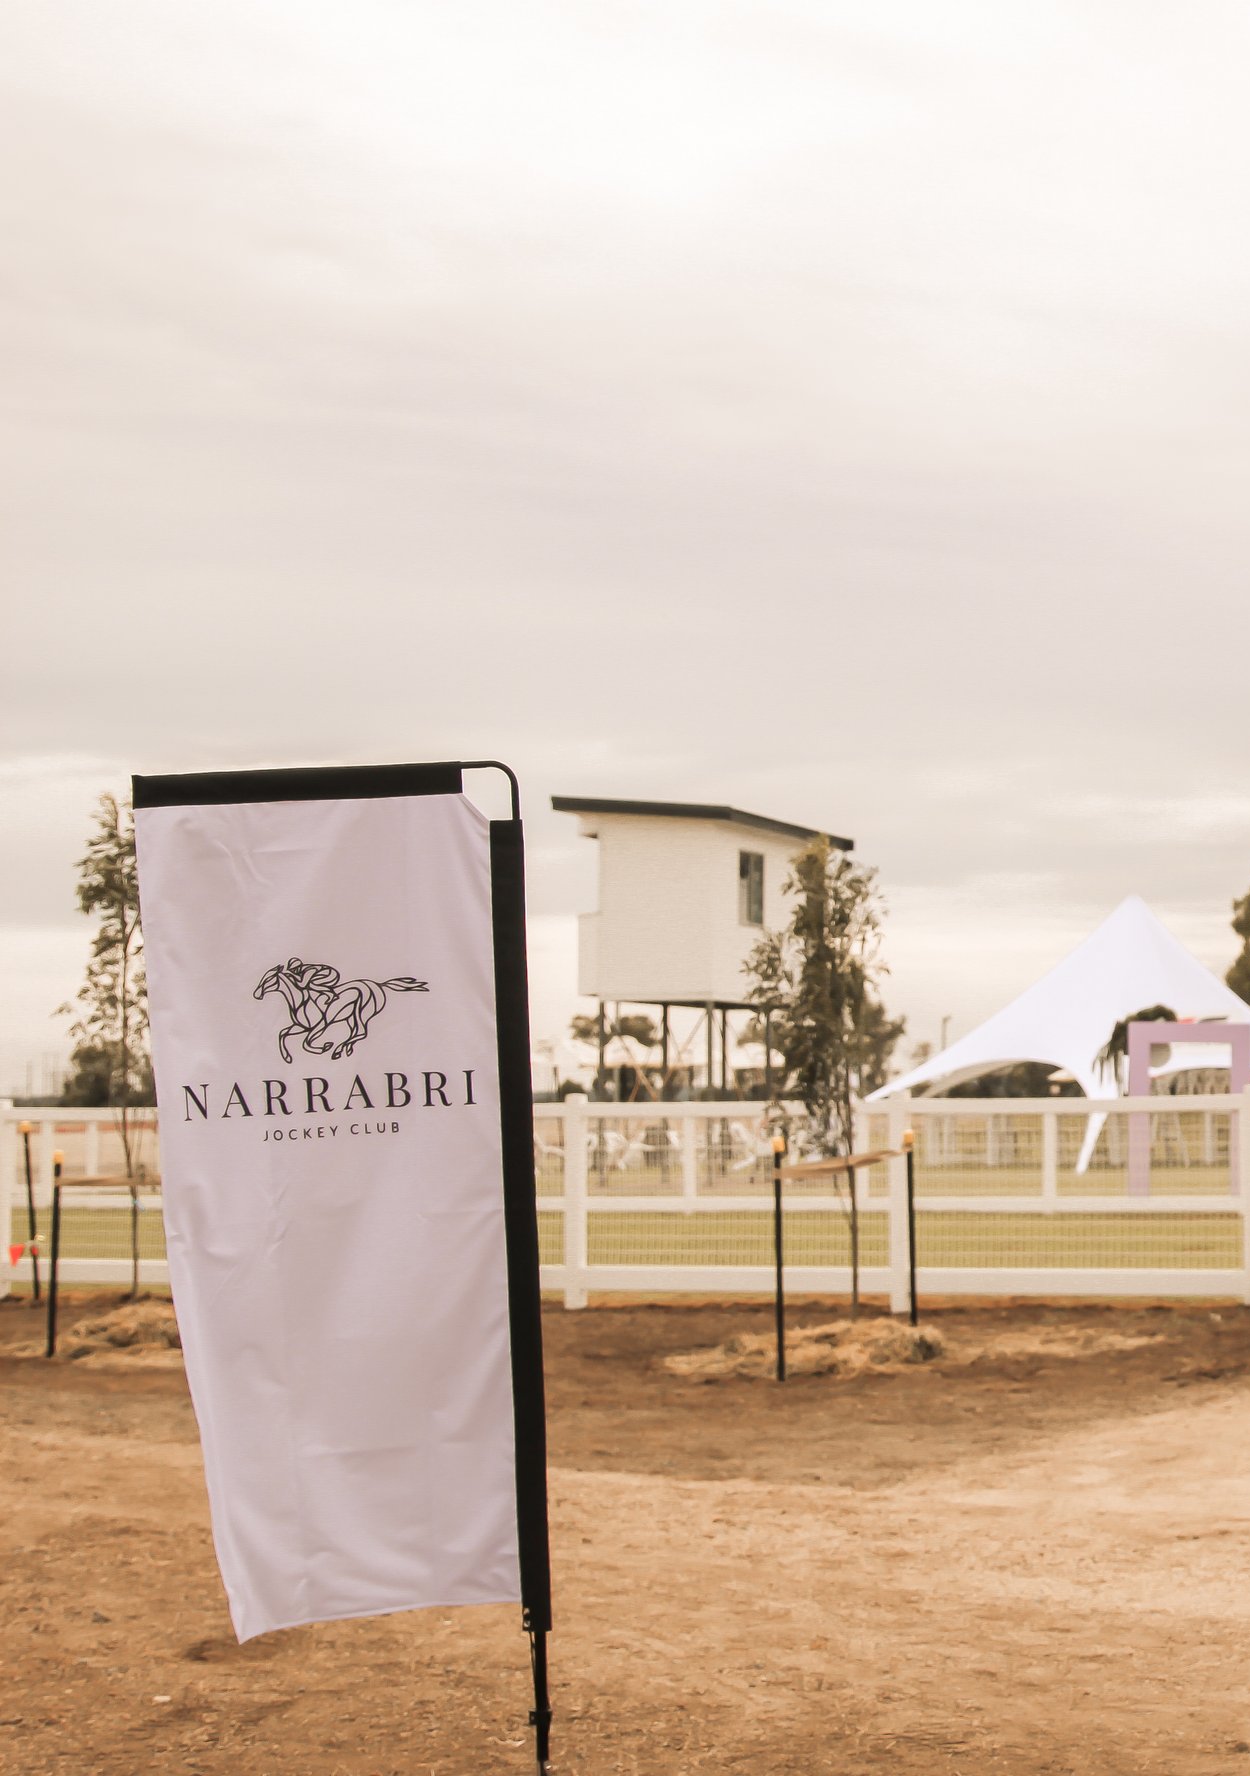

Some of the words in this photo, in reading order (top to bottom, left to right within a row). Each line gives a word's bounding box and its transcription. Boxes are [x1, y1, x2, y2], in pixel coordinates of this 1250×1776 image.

[182, 1069, 479, 1122] NARRABRI
[263, 1125, 339, 1142] JOCKEY
[350, 1122, 401, 1136] CLUB
